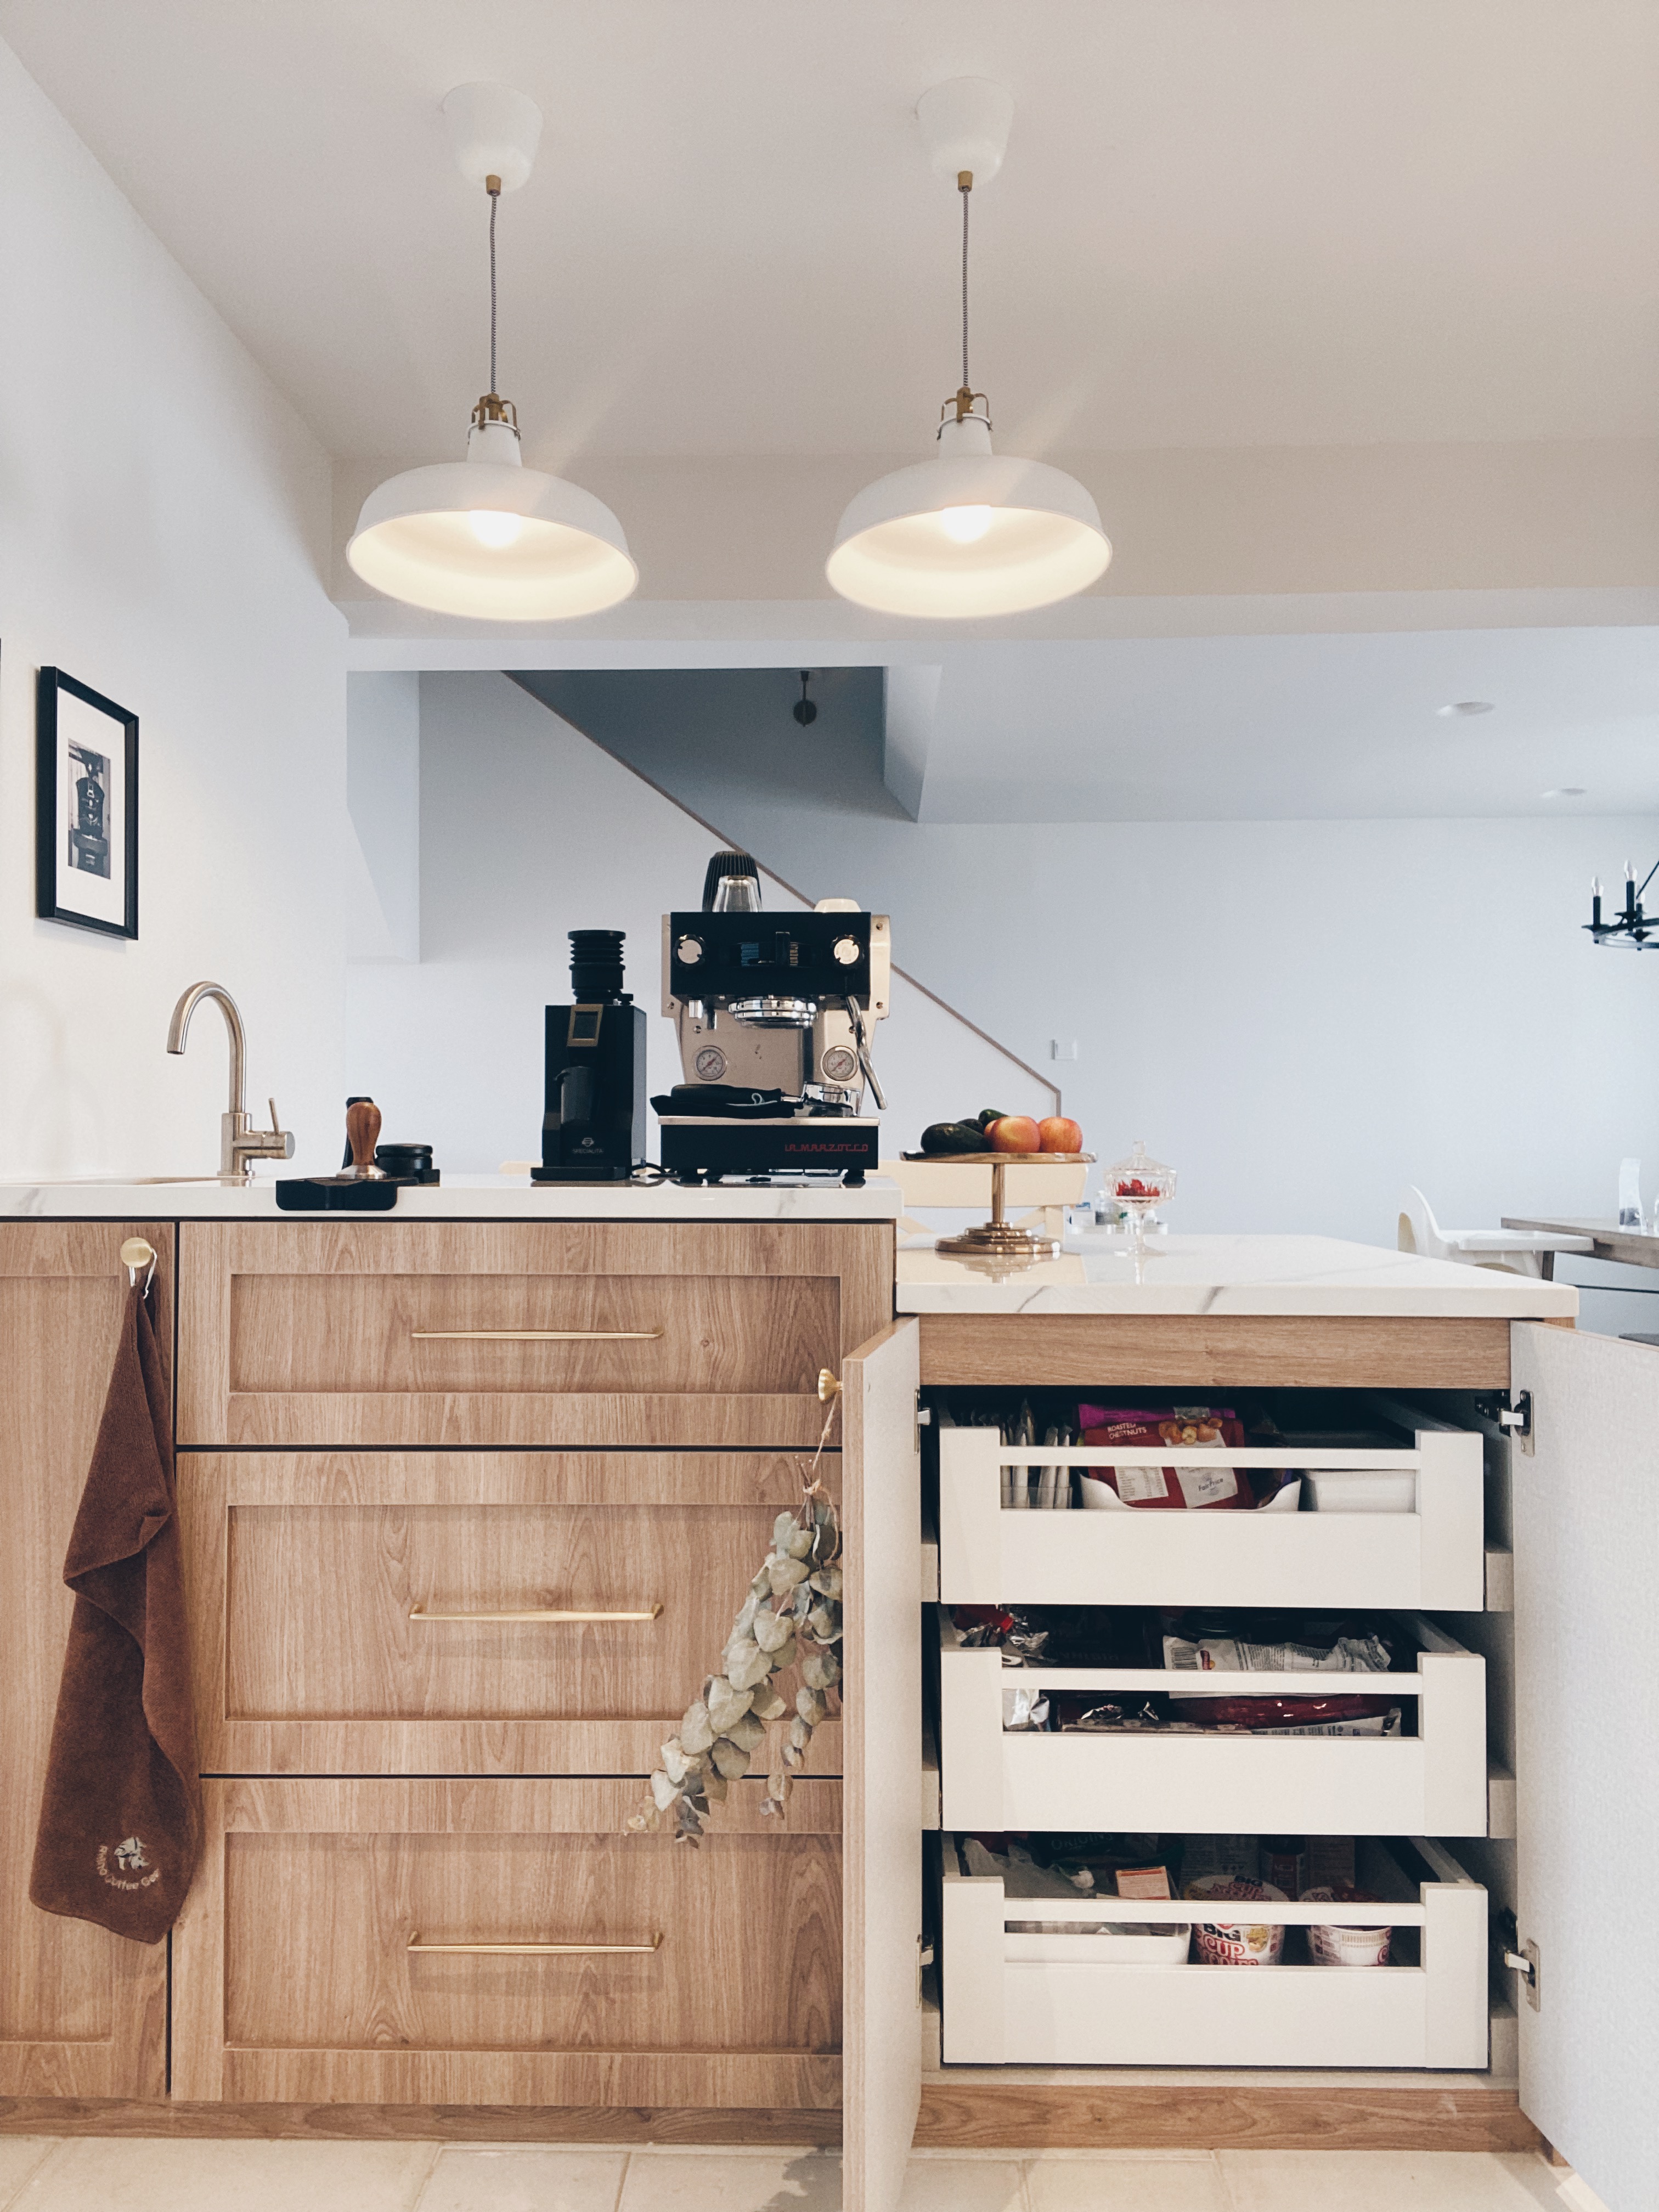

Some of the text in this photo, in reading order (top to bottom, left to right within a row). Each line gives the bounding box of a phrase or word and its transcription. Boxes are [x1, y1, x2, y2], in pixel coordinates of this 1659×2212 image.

[1109, 1426, 1147, 1440] CHESTNUTS
[1203, 1924, 1241, 1942] BIG
[1203, 1934, 1245, 1959] CUP
